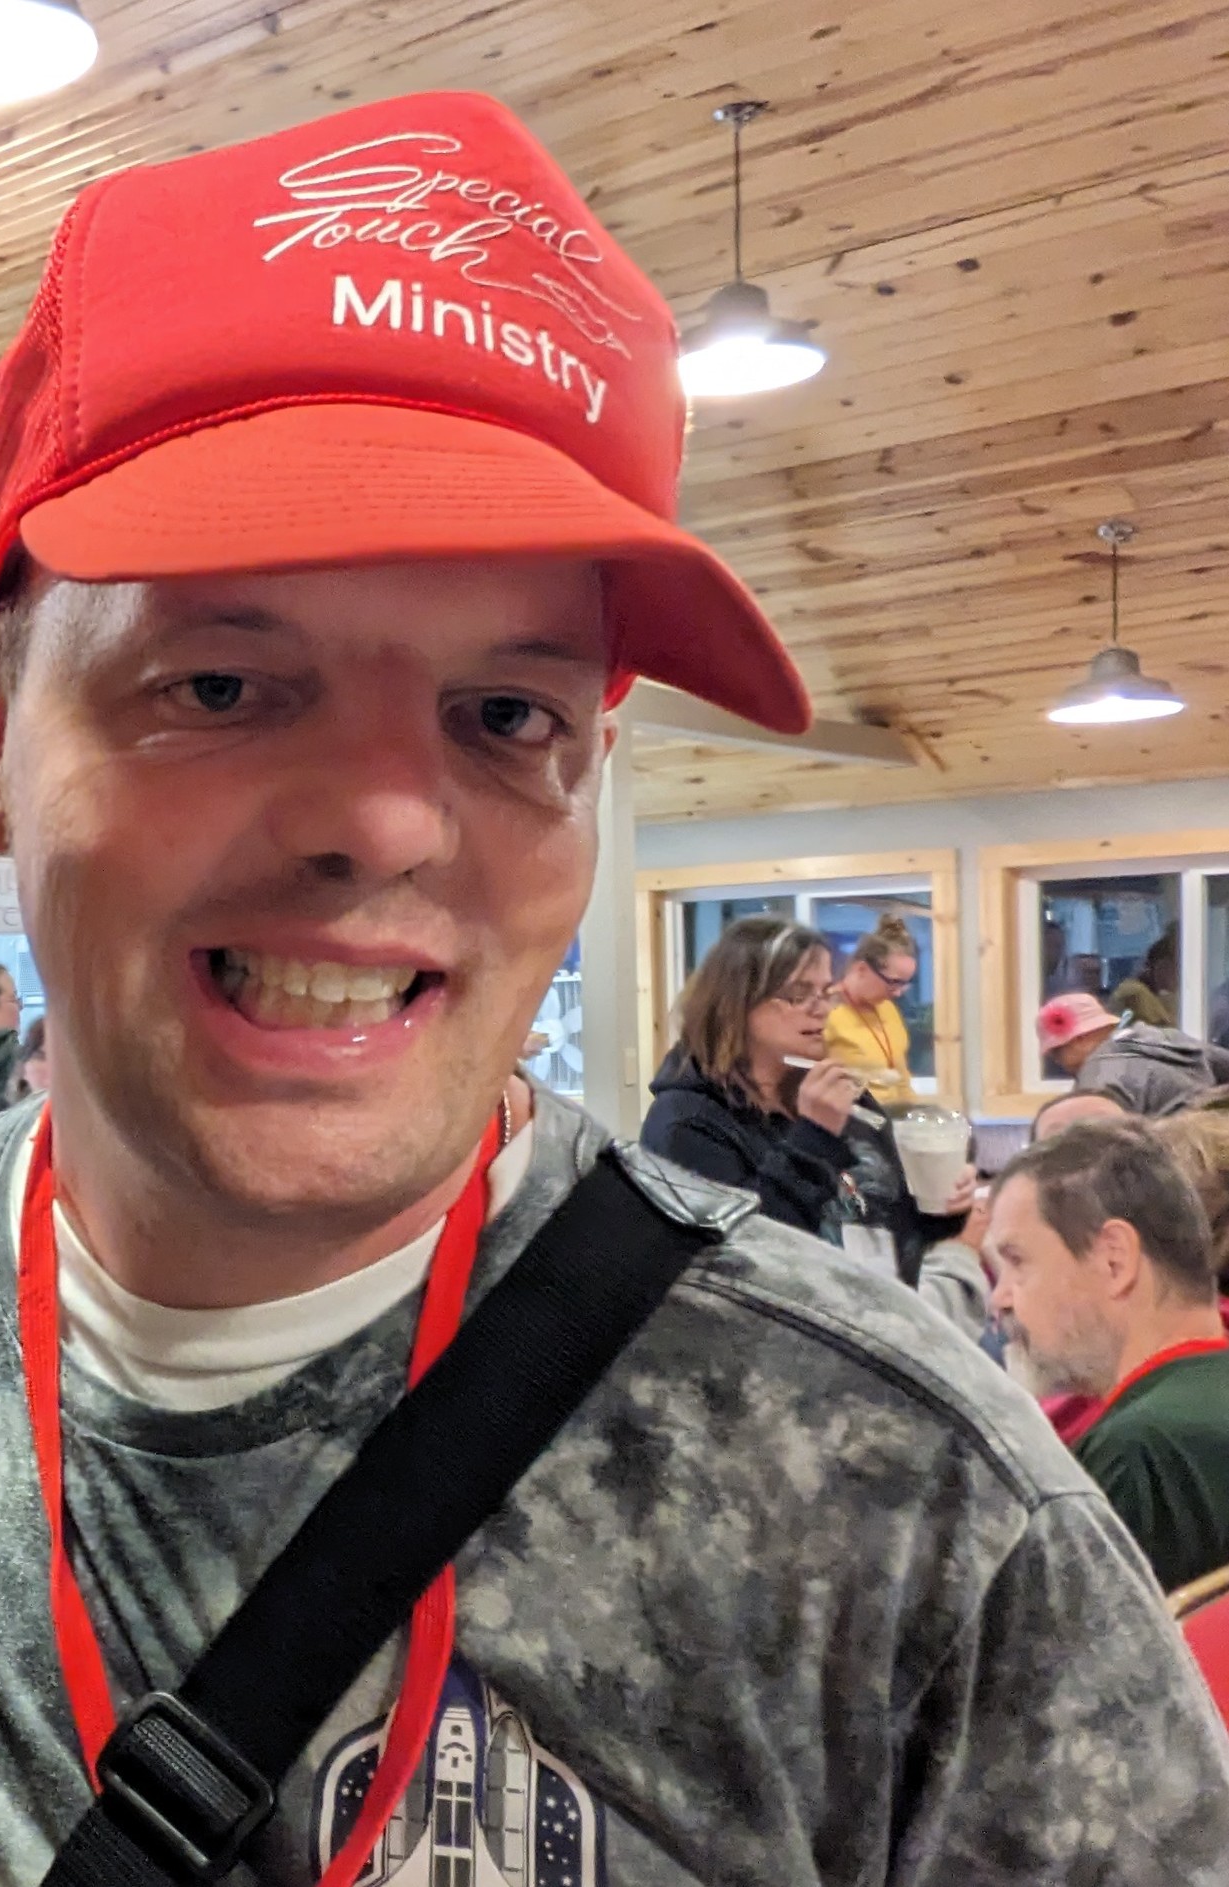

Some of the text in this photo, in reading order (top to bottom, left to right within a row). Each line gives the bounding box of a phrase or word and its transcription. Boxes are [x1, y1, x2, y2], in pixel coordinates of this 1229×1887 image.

[254, 201, 513, 268] Touch
[279, 133, 614, 277] Special
[331, 273, 607, 424] Ministry
